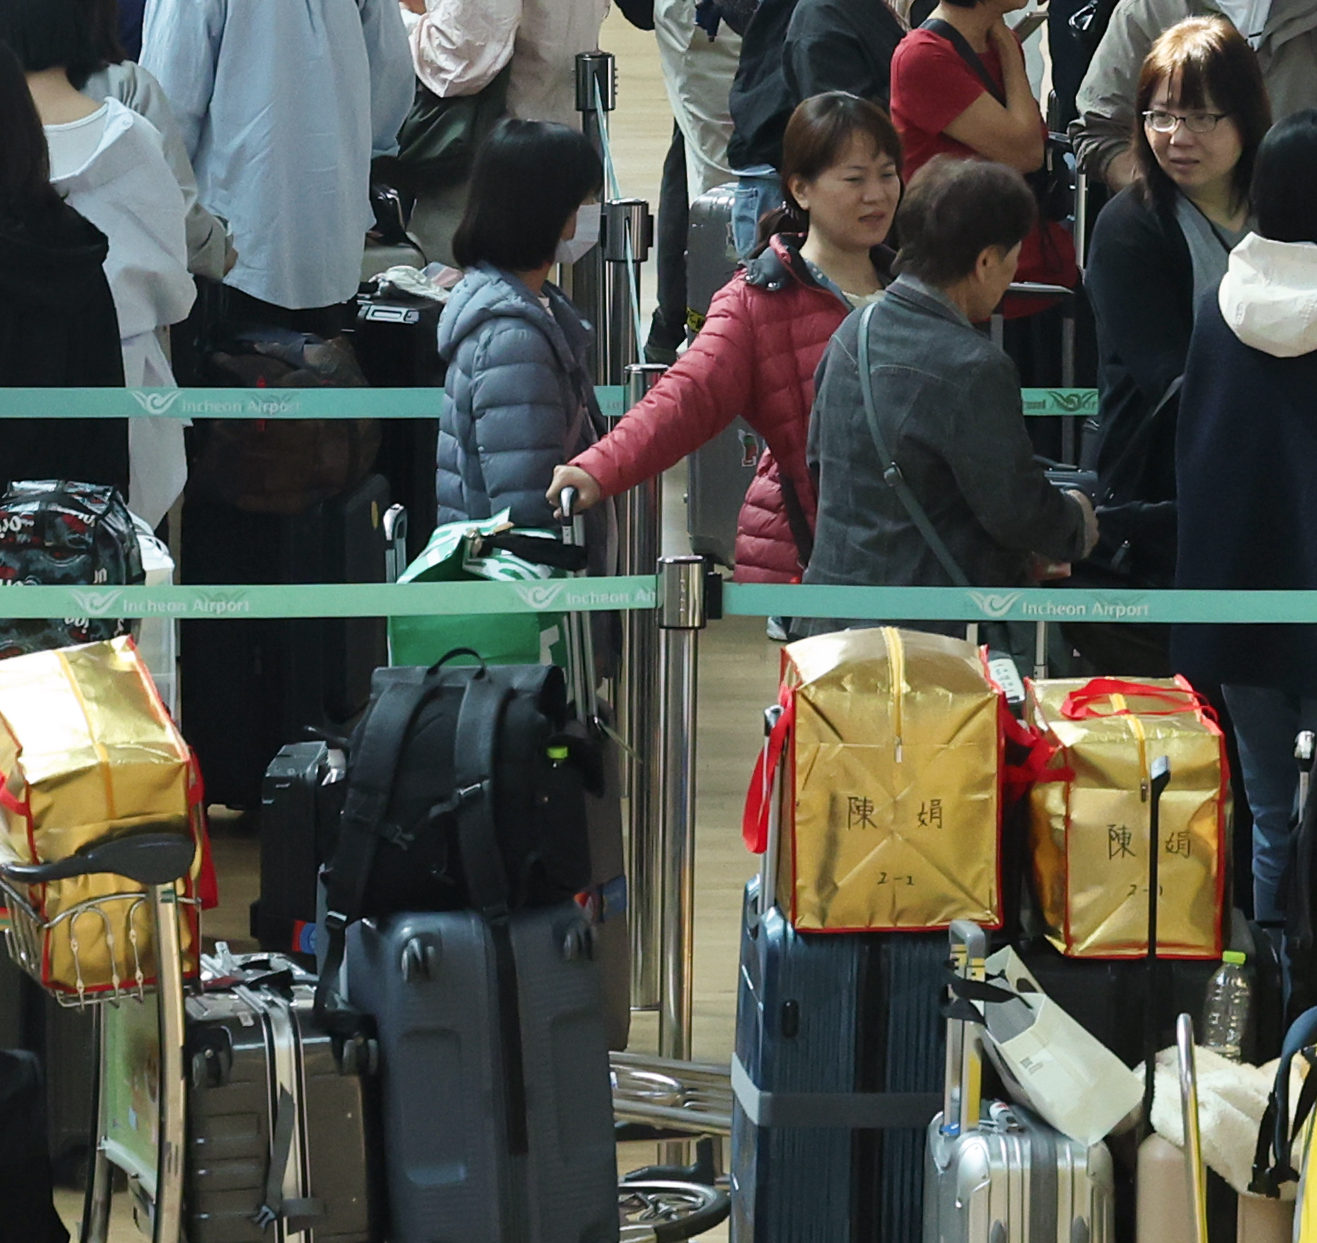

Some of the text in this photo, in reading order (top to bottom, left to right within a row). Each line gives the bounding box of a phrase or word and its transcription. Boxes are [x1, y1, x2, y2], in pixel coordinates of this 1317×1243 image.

[182, 400, 301, 416] Incheon Airport
[566, 591, 630, 605] Incheon
[123, 598, 250, 617] Incheon Airport
[1022, 601, 1150, 620] Incheon Airport
